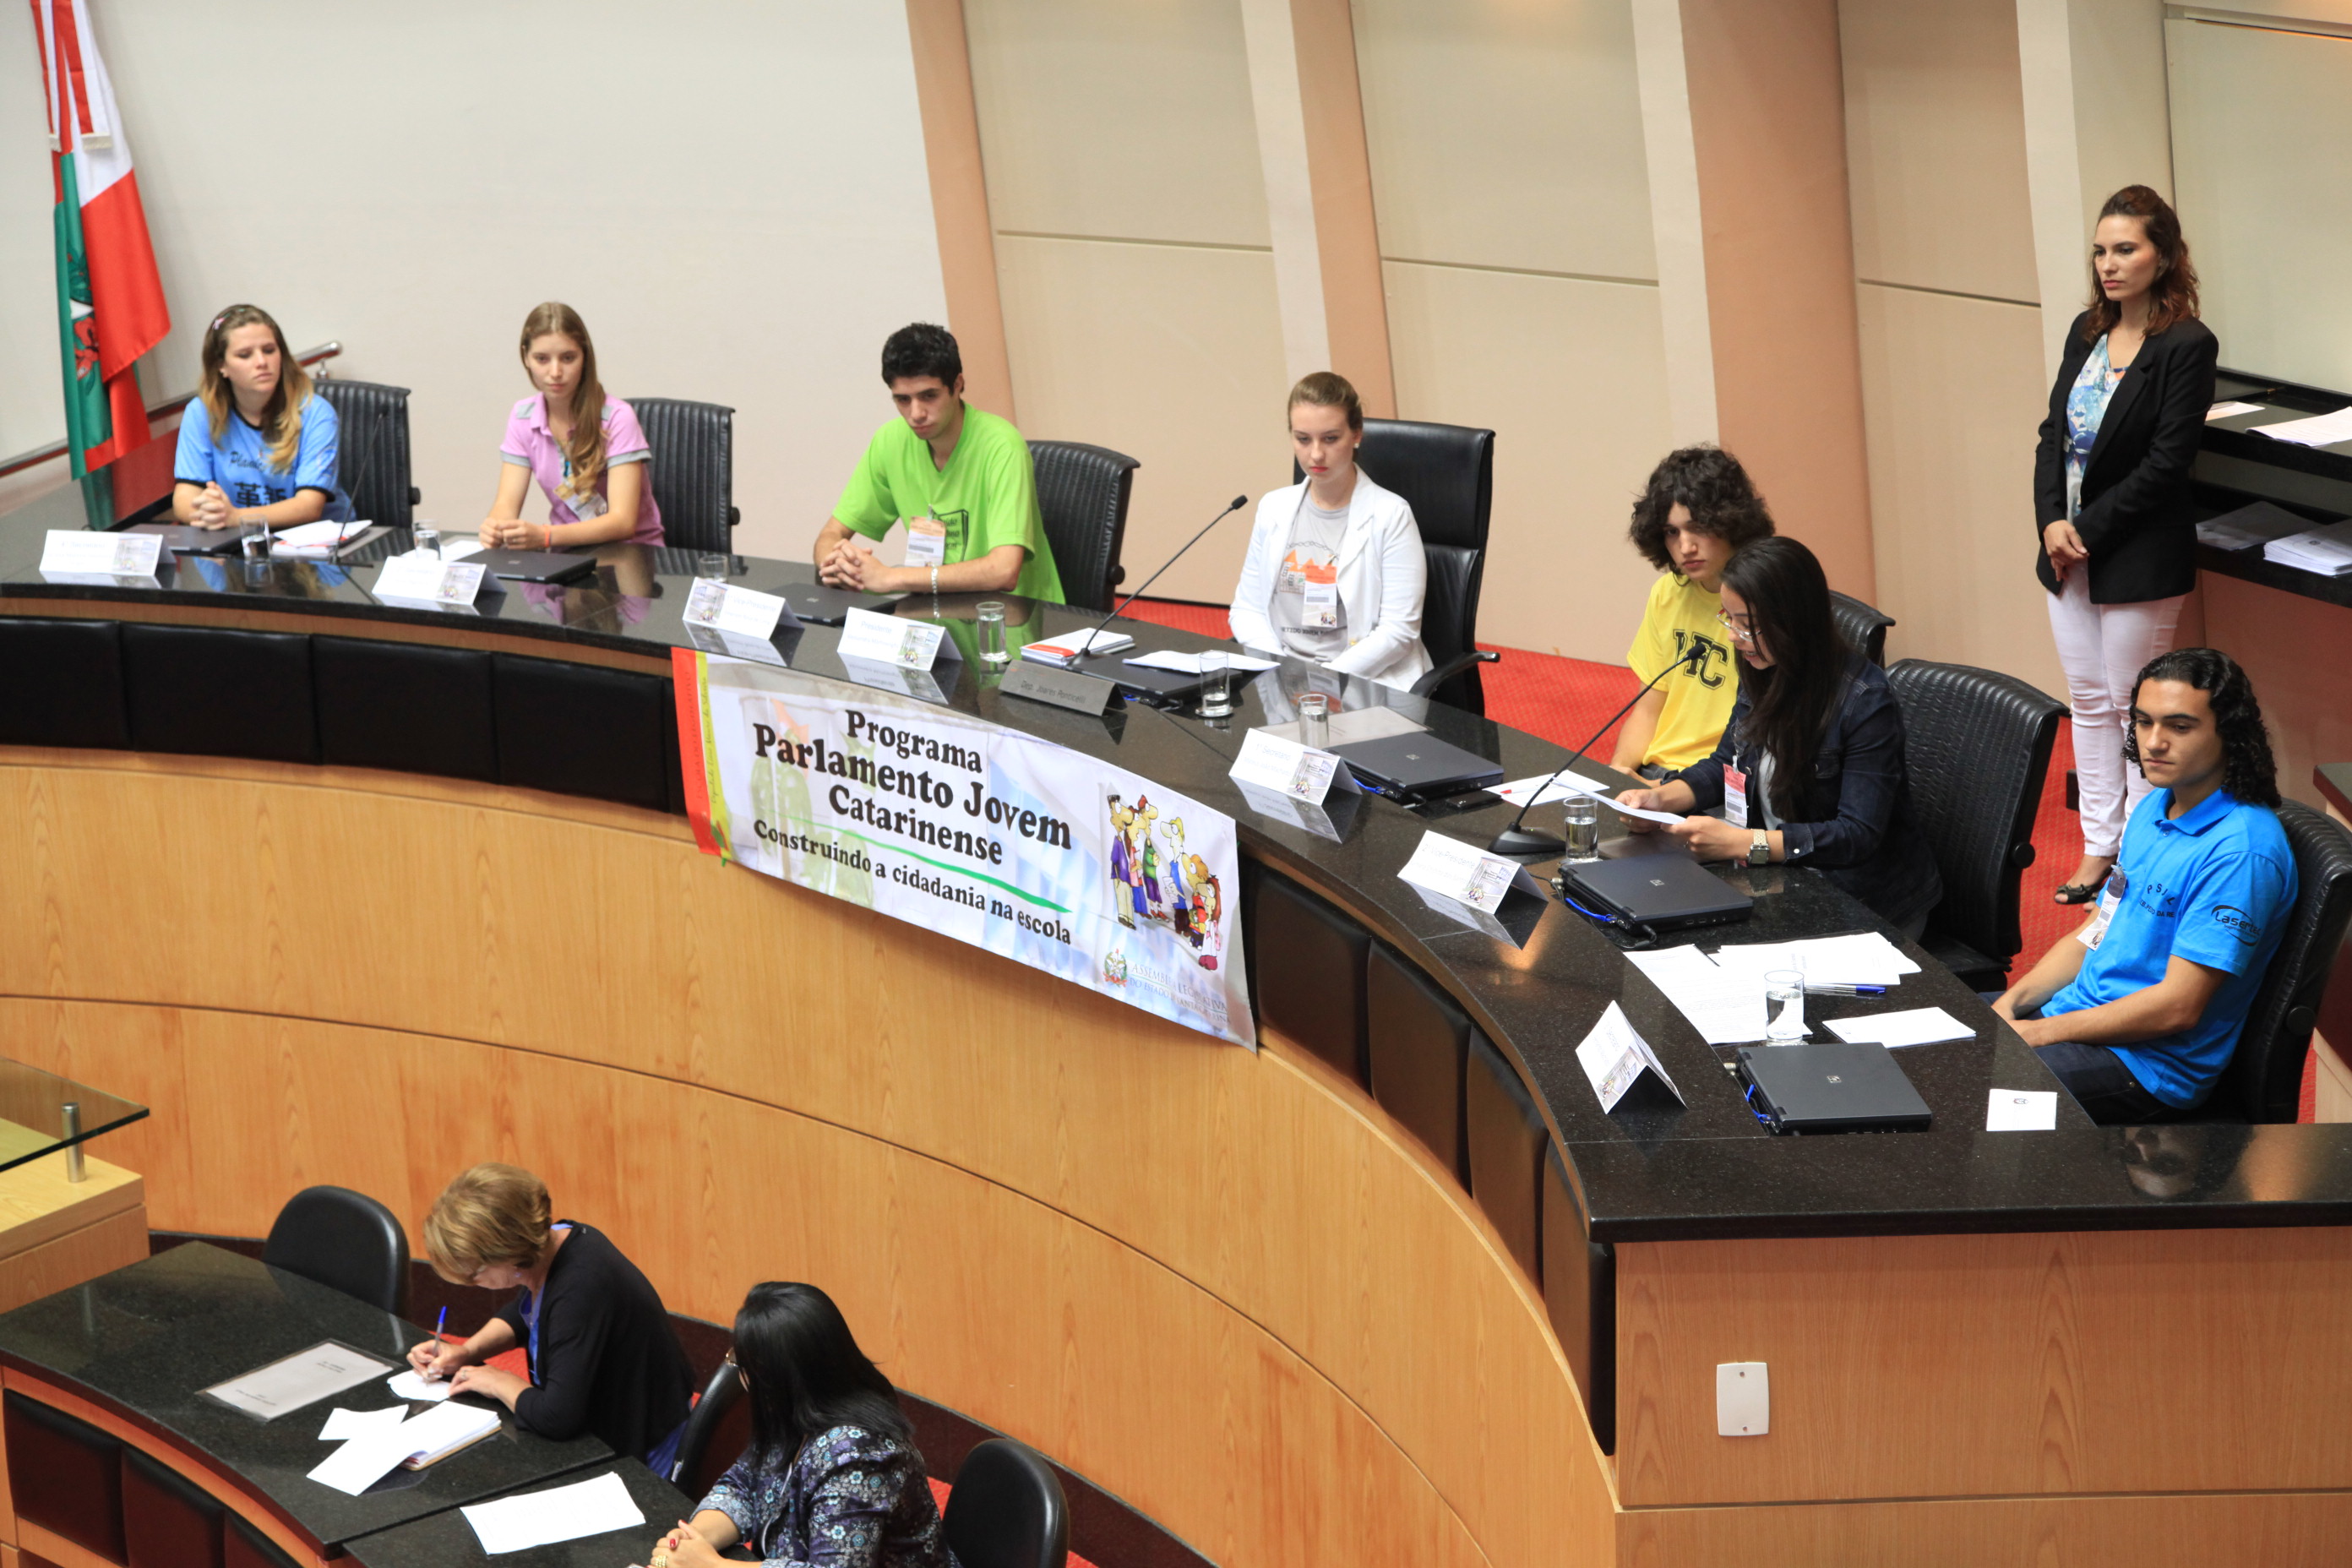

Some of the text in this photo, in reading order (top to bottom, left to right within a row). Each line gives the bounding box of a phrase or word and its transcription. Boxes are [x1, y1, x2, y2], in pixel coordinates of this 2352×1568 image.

[846, 709, 983, 773] Programa
[753, 723, 1072, 850] Parlamento Jovem
[829, 785, 1003, 865] Catarinense
[754, 819, 1071, 945] Construindo a cidadania na escola
[1130, 977, 1141, 988] DO
[1144, 982, 1169, 999] ESTADO
